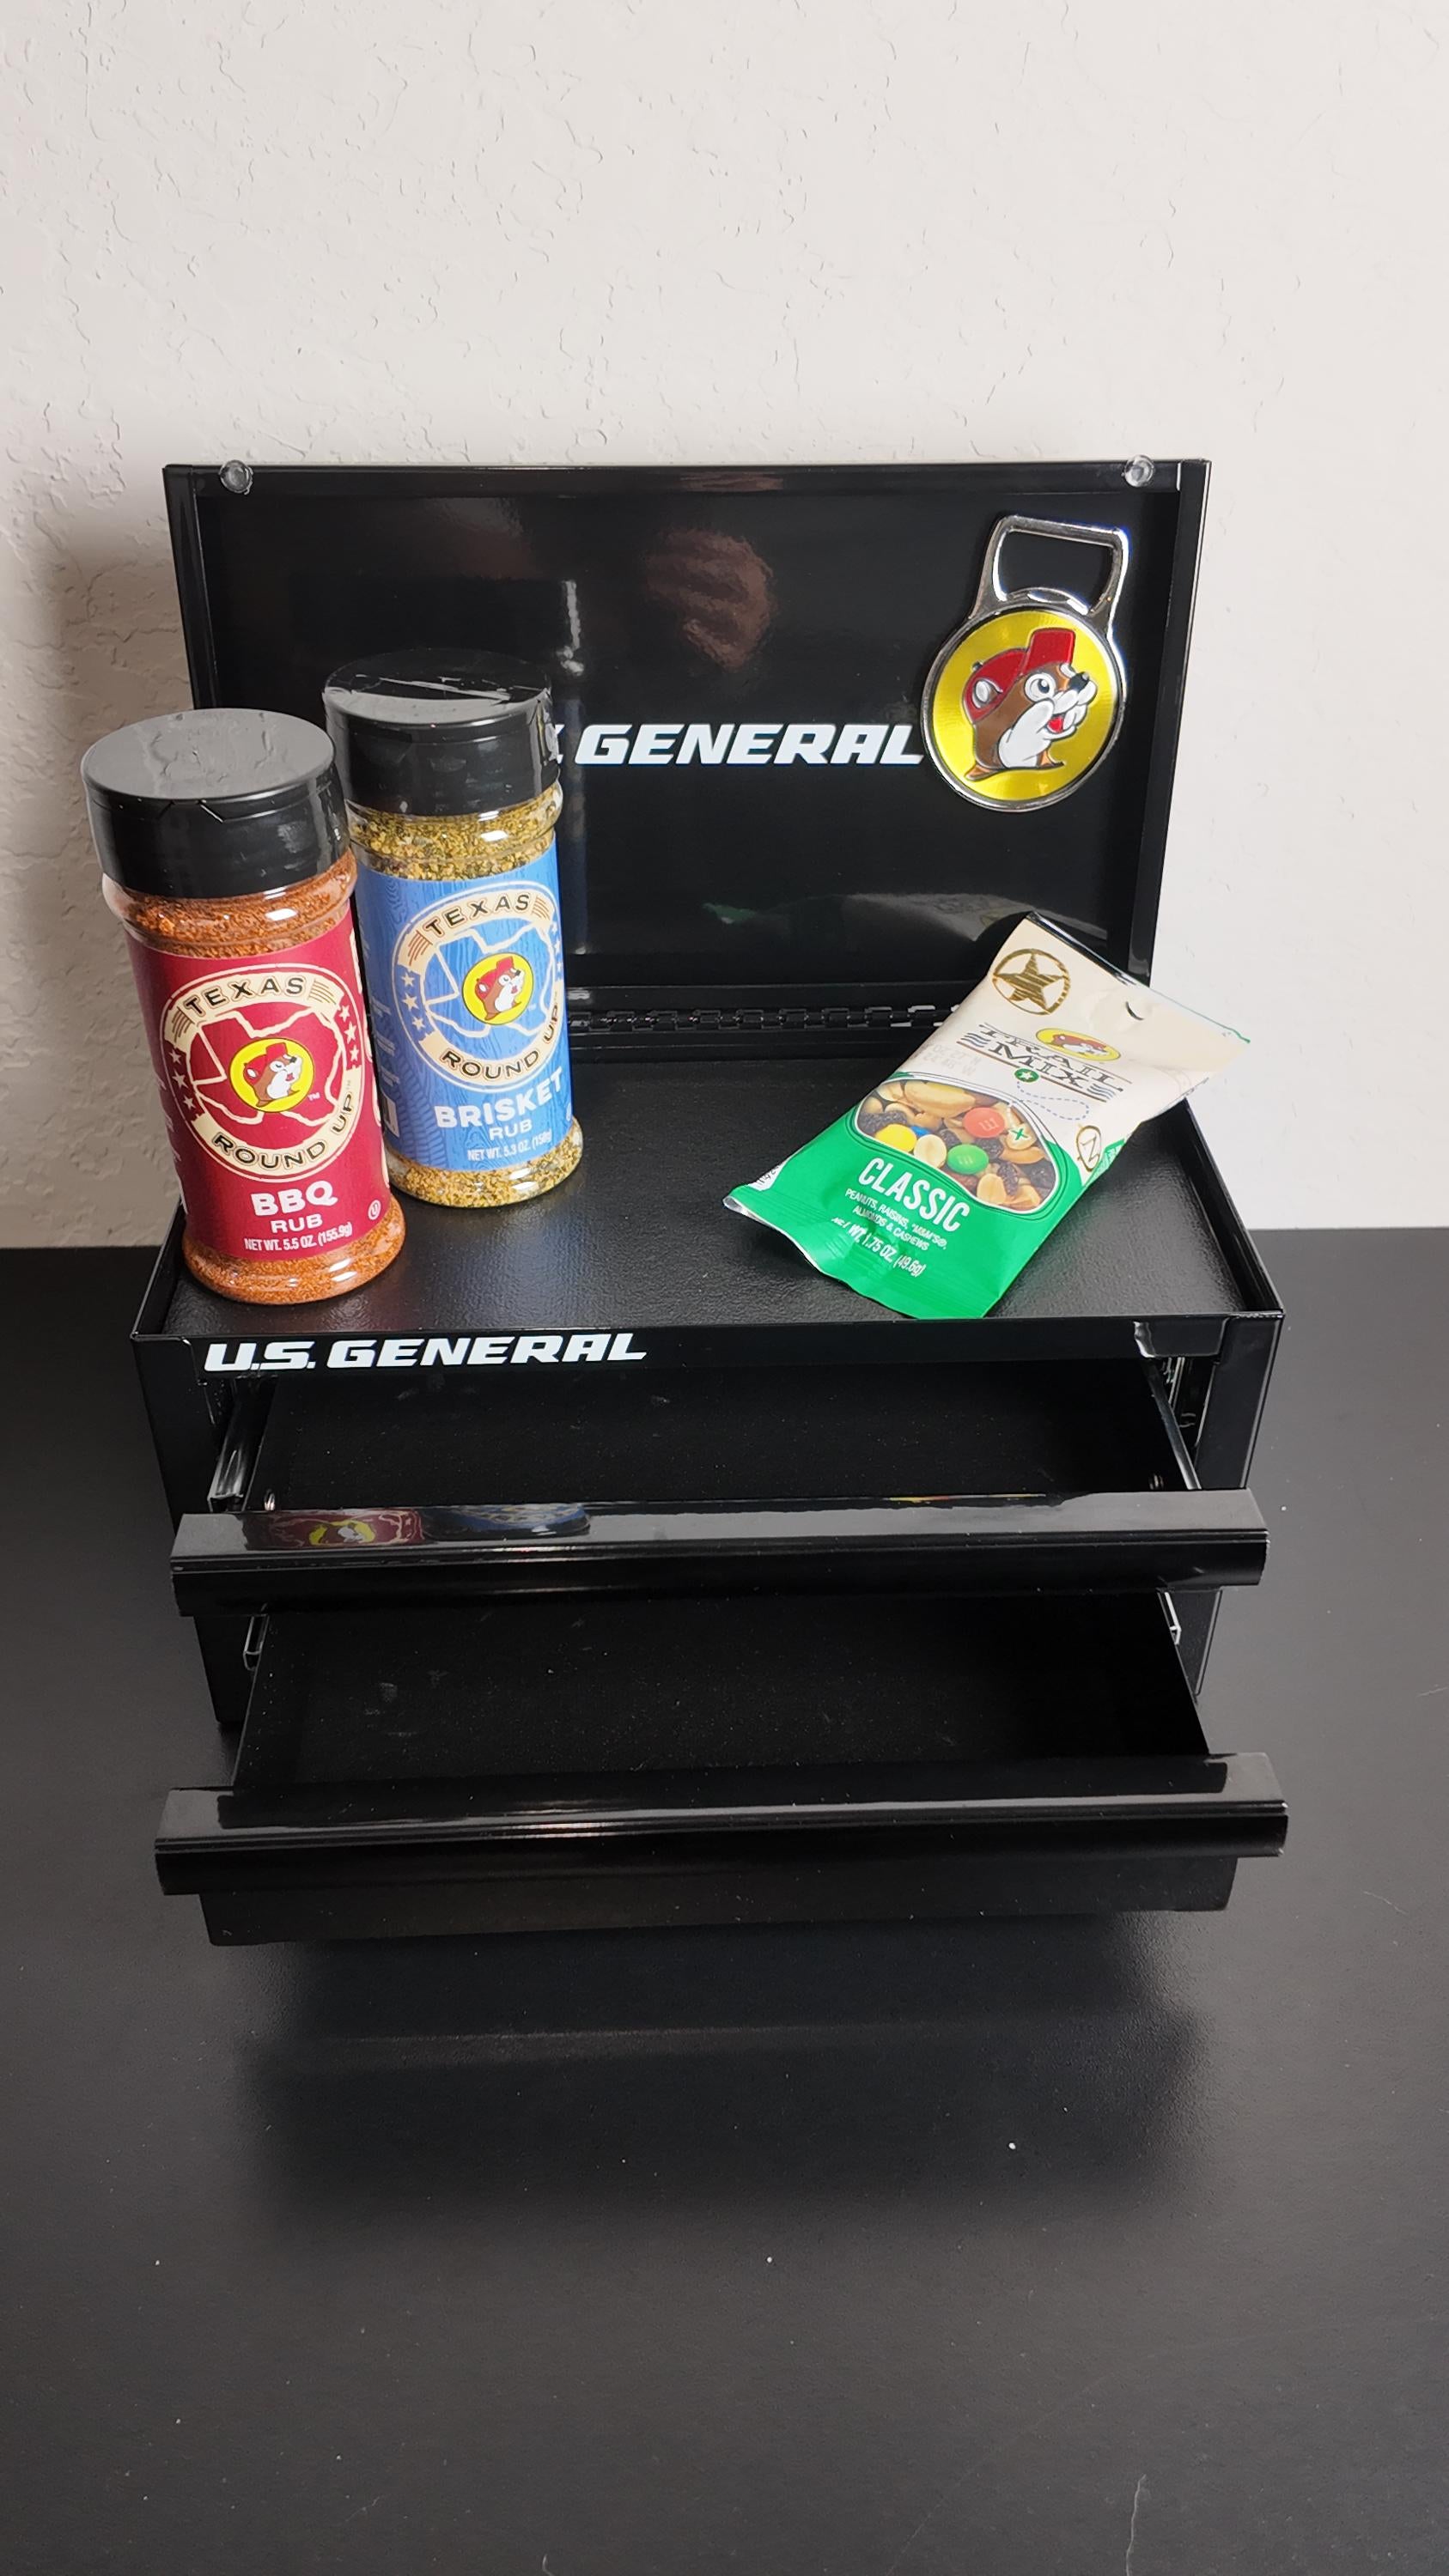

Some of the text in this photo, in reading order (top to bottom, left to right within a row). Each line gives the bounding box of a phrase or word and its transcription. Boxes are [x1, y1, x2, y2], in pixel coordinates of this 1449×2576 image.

[575, 724, 925, 764] GENERAL
[426, 894, 530, 935] TEXAS
[184, 977, 305, 1015] TEXAS
[442, 1005, 557, 1079] ROUND UP
[979, 1023, 1123, 1093] TRAIL
[989, 1042, 1083, 1089] MIX
[434, 1066, 563, 1127] BRISKET
[214, 1093, 352, 1169] ROUND UP
[489, 1119, 533, 1141] RUB
[467, 1148, 484, 1161] NET
[503, 1144, 517, 1157] 5.3
[251, 1181, 338, 1216] BBQ
[859, 1158, 970, 1231] CLASSIC
[244, 1237, 262, 1251] NET
[264, 1239, 282, 1251] WT.
[283, 1237, 299, 1251] 5.5
[318, 1222, 353, 1246] (155.9g)
[271, 1213, 323, 1233] RUB
[893, 1227, 929, 1251] CASHEWS
[861, 1233, 884, 1253] 1.75
[204, 1333, 647, 1371] U.S. GENERAL
